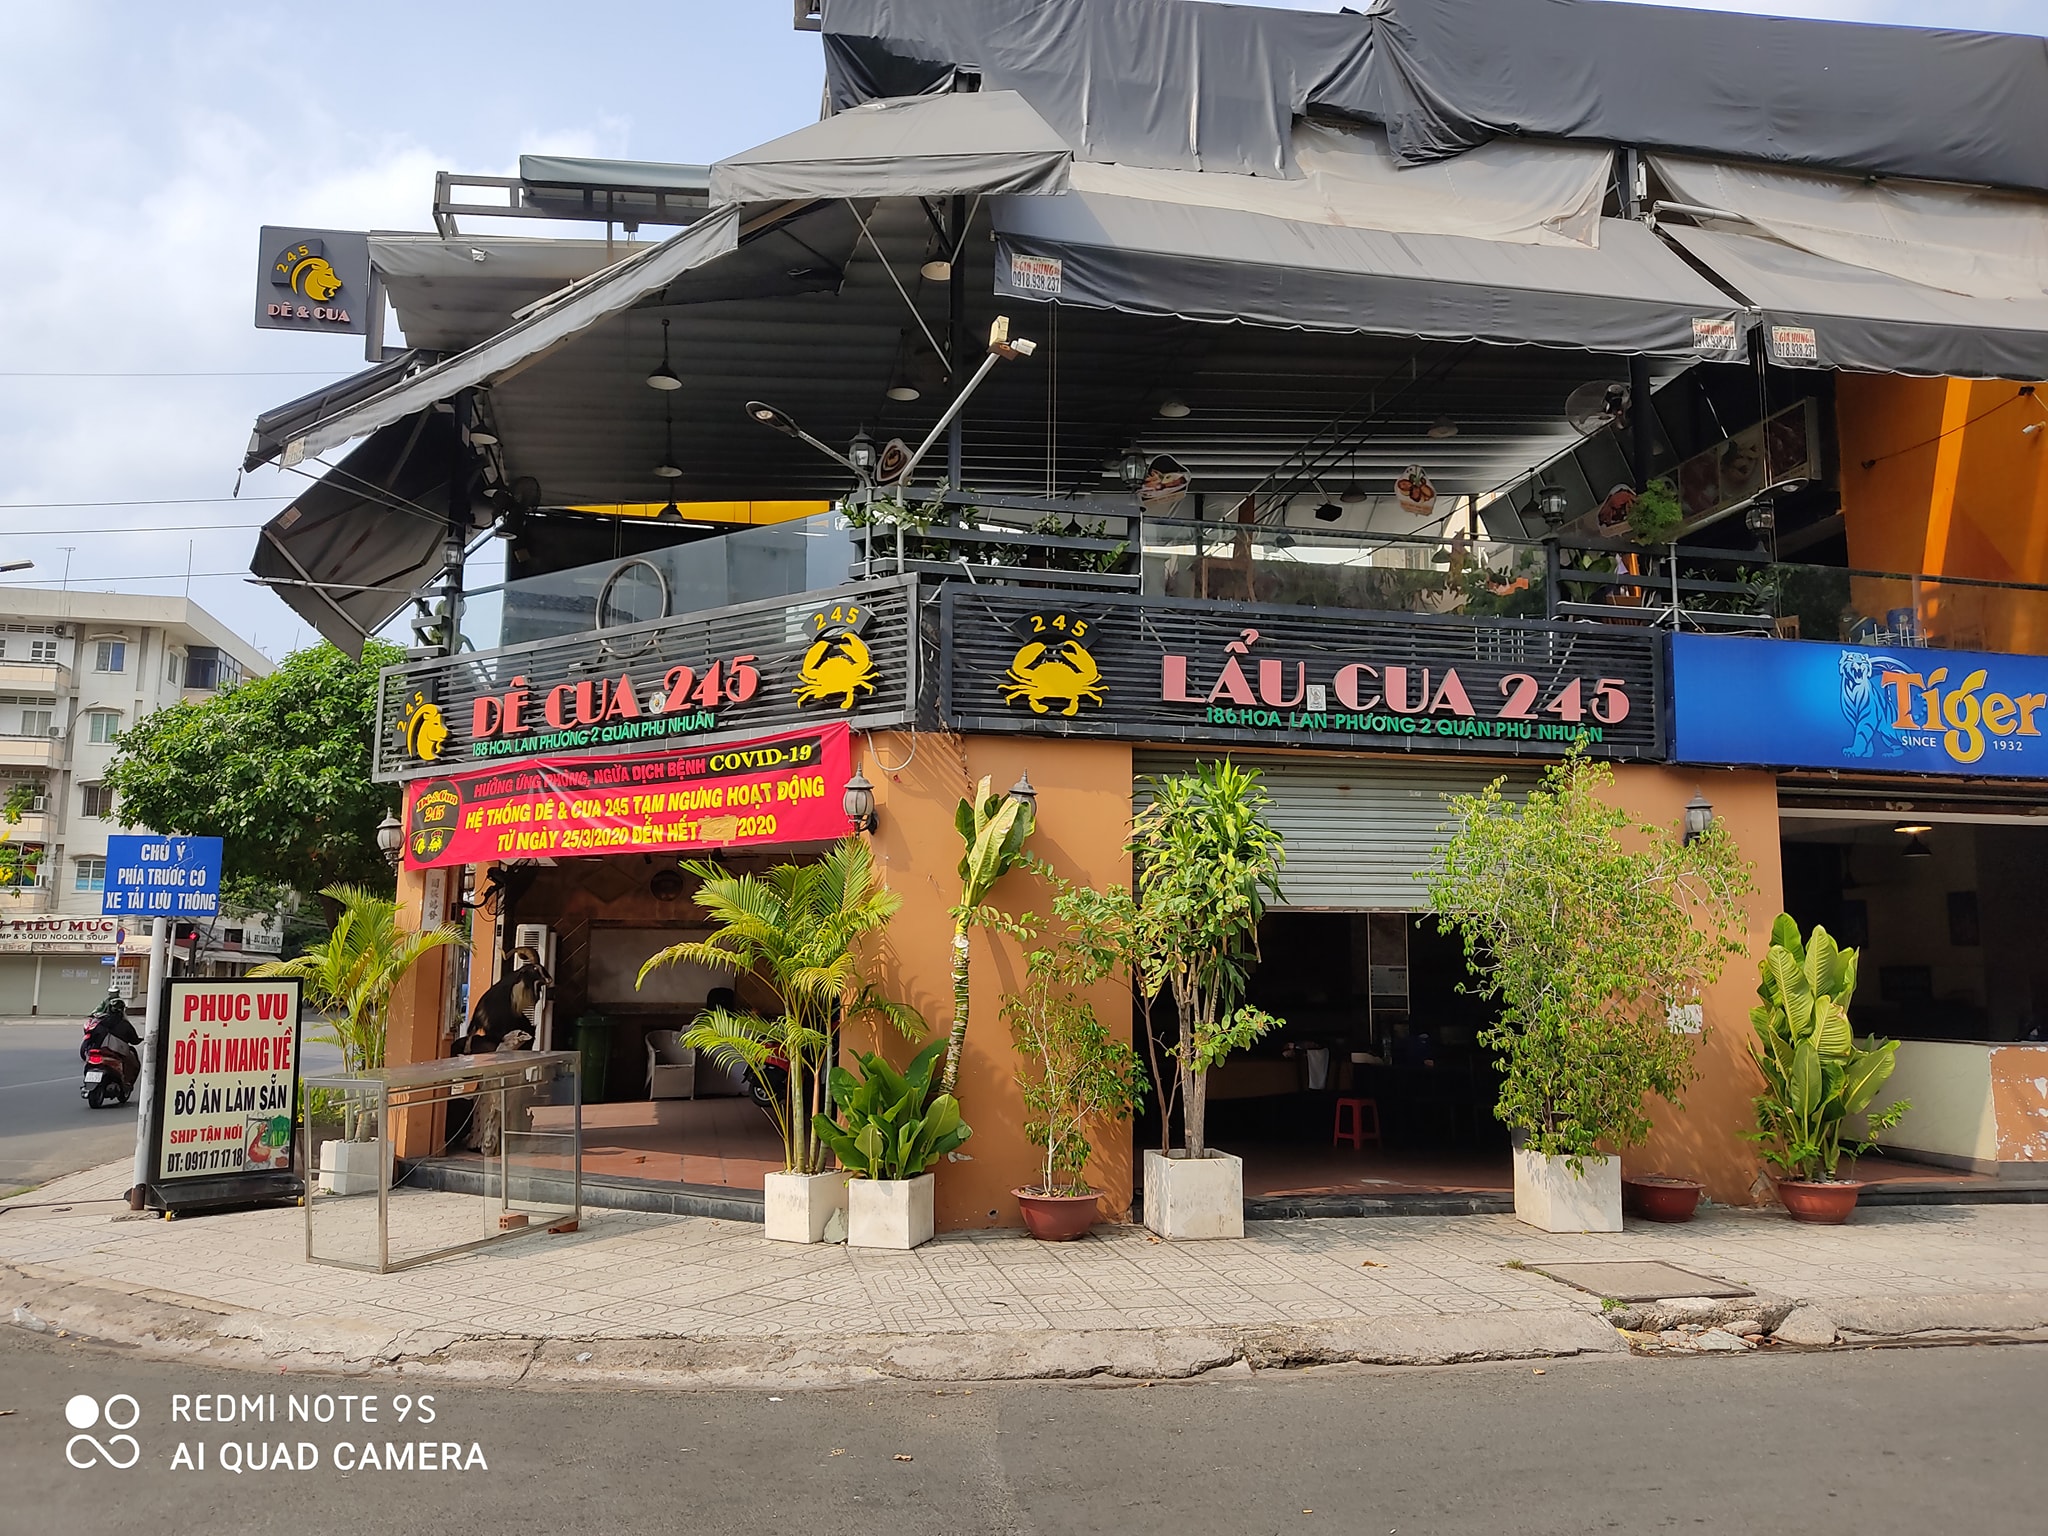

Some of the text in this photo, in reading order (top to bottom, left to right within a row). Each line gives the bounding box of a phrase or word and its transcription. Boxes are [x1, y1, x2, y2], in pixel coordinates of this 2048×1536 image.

[267, 302, 350, 322] DÊ & CUA
[814, 606, 860, 632] 245
[1030, 614, 1089, 638] 245
[1162, 628, 1631, 724] LẨU CUA 245
[472, 655, 760, 738] DÊ CUA 245
[1206, 707, 1237, 724] 186
[1240, 709, 1282, 727] HOA
[1291, 711, 1328, 729] LAN
[1335, 712, 1416, 733] PHƯƠNG
[1420, 718, 1432, 734] 2
[1495, 719, 1532, 739] PHÚ
[1881, 667, 2048, 764] Tiger
[472, 741, 489, 757] 188
[489, 740, 512, 755] HOA
[514, 736, 538, 753] LAN
[539, 730, 588, 750] PHƯƠNG
[590, 726, 599, 742] 2
[1901, 735, 1937, 748] SINCE
[1993, 740, 2023, 751] 1932
[594, 764, 630, 784] NGỪA
[632, 763, 664, 784] DỊCH
[667, 758, 706, 780] BỆNH
[709, 744, 812, 772] COVID-19
[465, 774, 825, 833] HỆ THỐNG DÊ & CUA 245 TẠM NGƯNG HOẠT ĐỘNG
[497, 828, 516, 851] TỪ
[516, 826, 560, 851] NGÀY
[561, 826, 629, 849] 25/3/2020
[631, 816, 664, 844] ĐẾN
[667, 813, 698, 842] HẾT
[140, 841, 187, 861] CHÚ Ý
[117, 863, 207, 887] PHÍA TRƯỚC CÓ
[105, 892, 122, 909] XE
[127, 886, 145, 909] TẢI
[177, 889, 217, 911] THÔNG
[183, 993, 289, 1028] PHỤC VỤ
[174, 1026, 293, 1075] ĐỒ ĂN MANG VỀ
[174, 1073, 288, 1116] ĐỒ ĂN LÀM SẴN
[170, 1125, 243, 1145] SHIP TẬN NƠI
